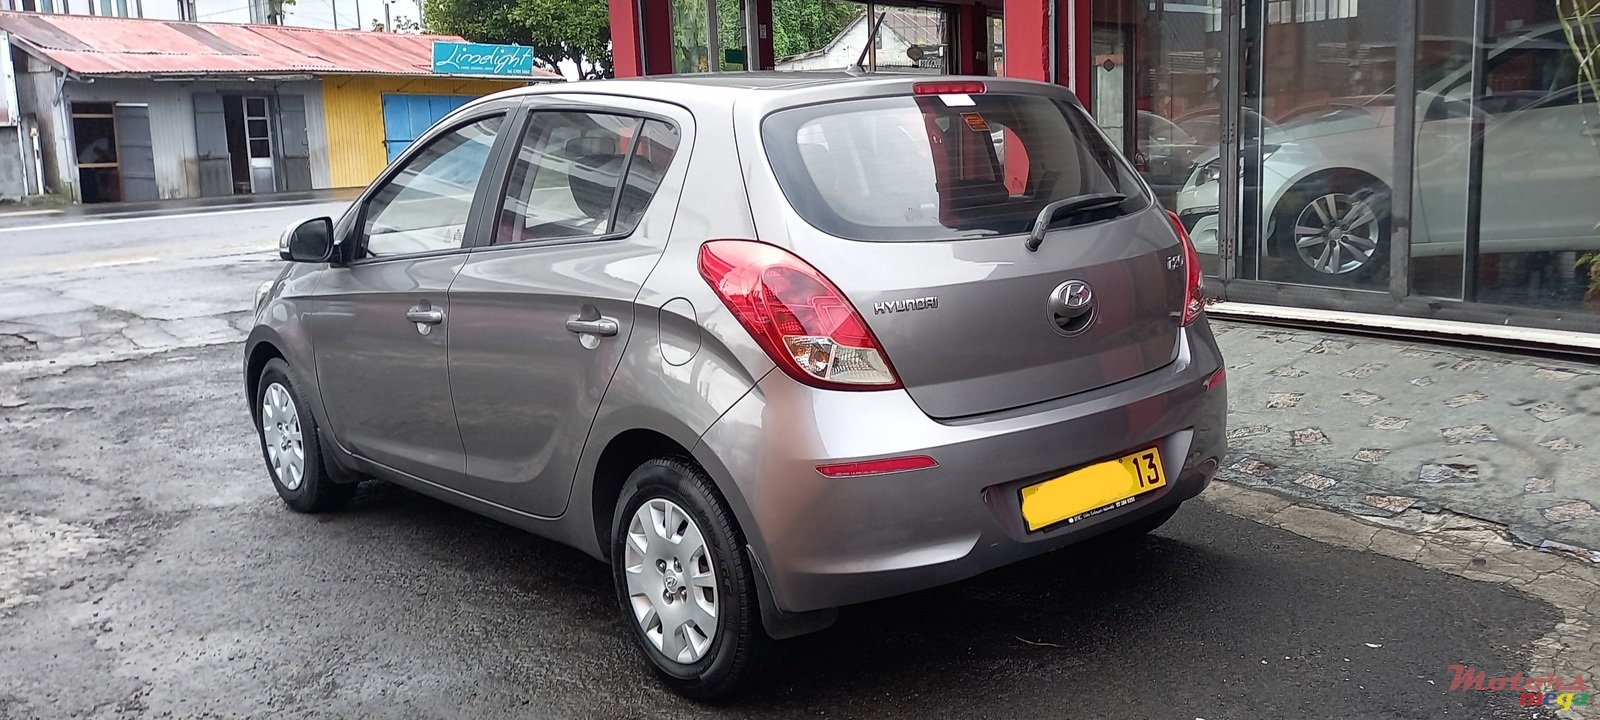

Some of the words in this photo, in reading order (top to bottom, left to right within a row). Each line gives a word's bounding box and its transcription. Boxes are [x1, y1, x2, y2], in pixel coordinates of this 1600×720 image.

[435, 44, 532, 74] Limelight
[873, 296, 939, 315] HYUNDAI
[1132, 452, 1160, 488] 13
